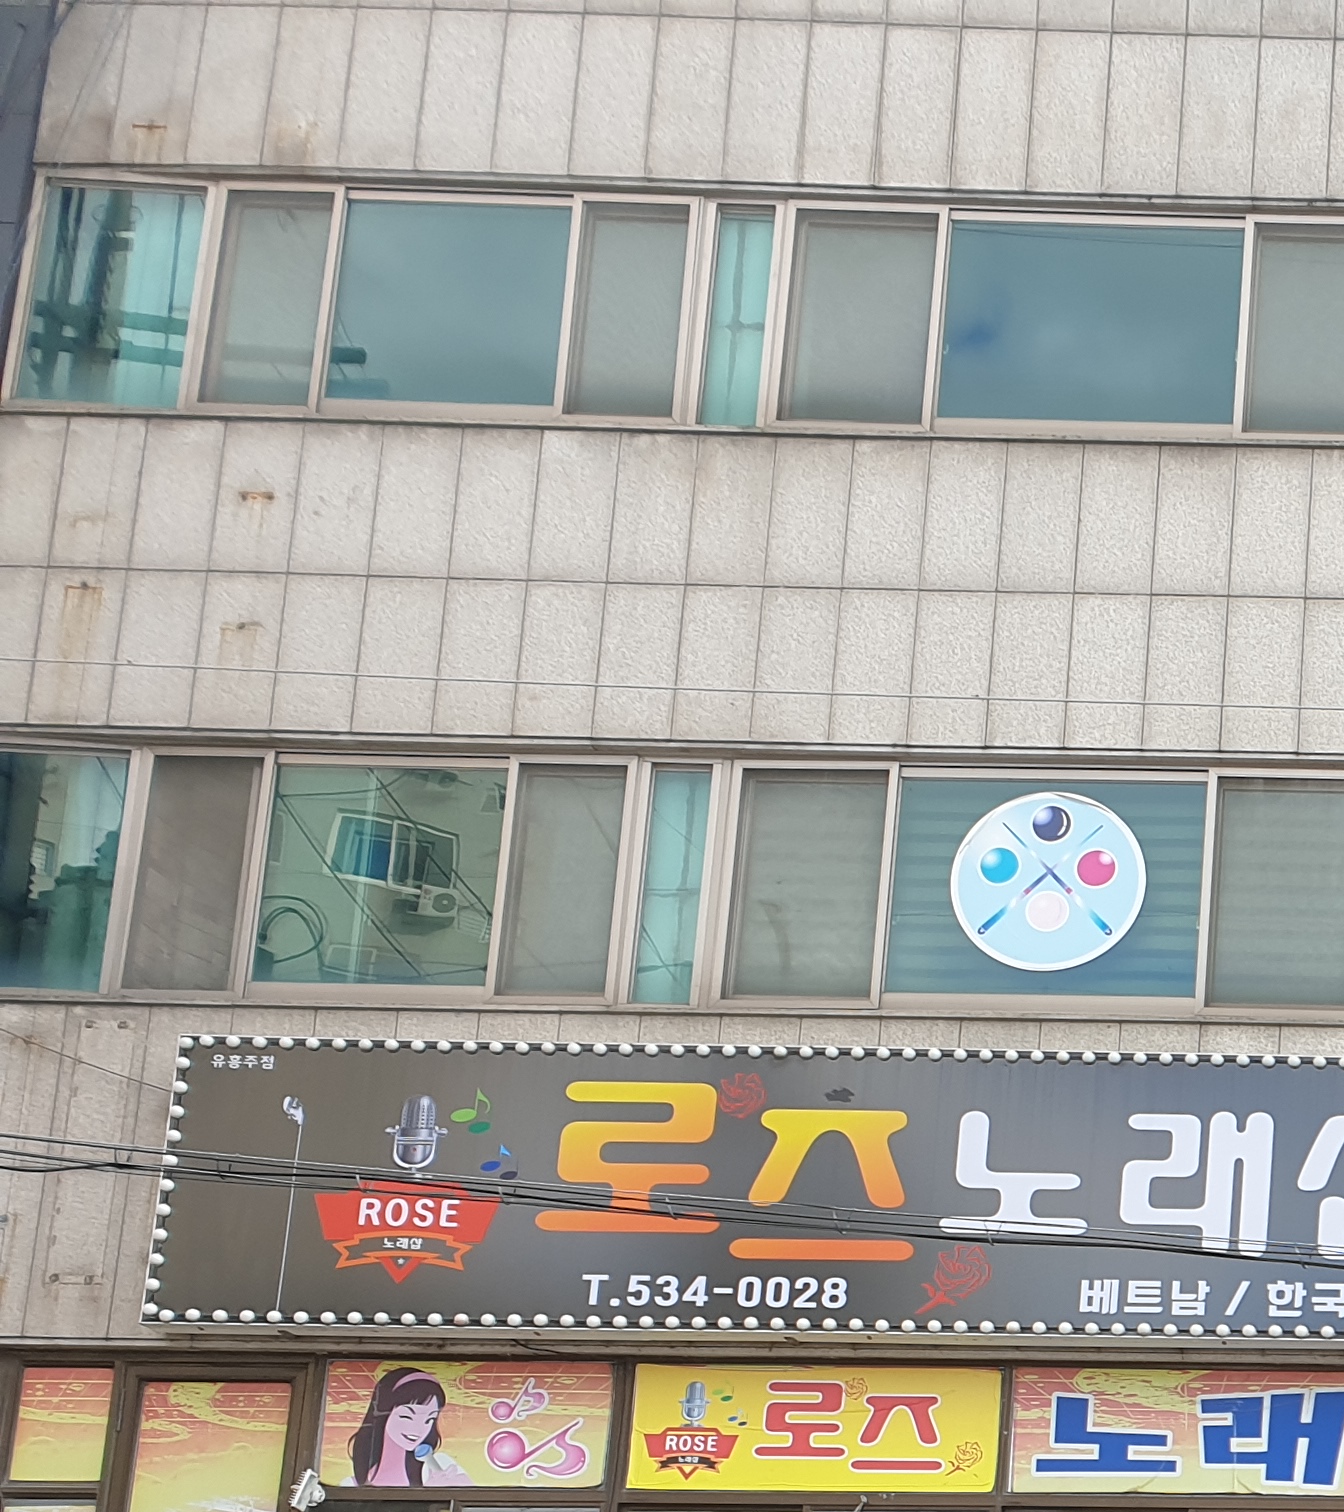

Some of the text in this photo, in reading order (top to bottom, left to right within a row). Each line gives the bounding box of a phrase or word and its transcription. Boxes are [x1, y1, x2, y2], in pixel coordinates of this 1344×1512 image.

[210, 1053, 276, 1070] 유흥주점
[535, 1081, 915, 1261] 로즈
[358, 1197, 460, 1229] ROSE
[382, 1237, 423, 1250] 노래샵
[581, 1274, 848, 1310] T.534-0028
[1079, 1279, 1211, 1318] 베트남
[665, 1435, 718, 1452] ROSE
[753, 1380, 947, 1474] 로즈
